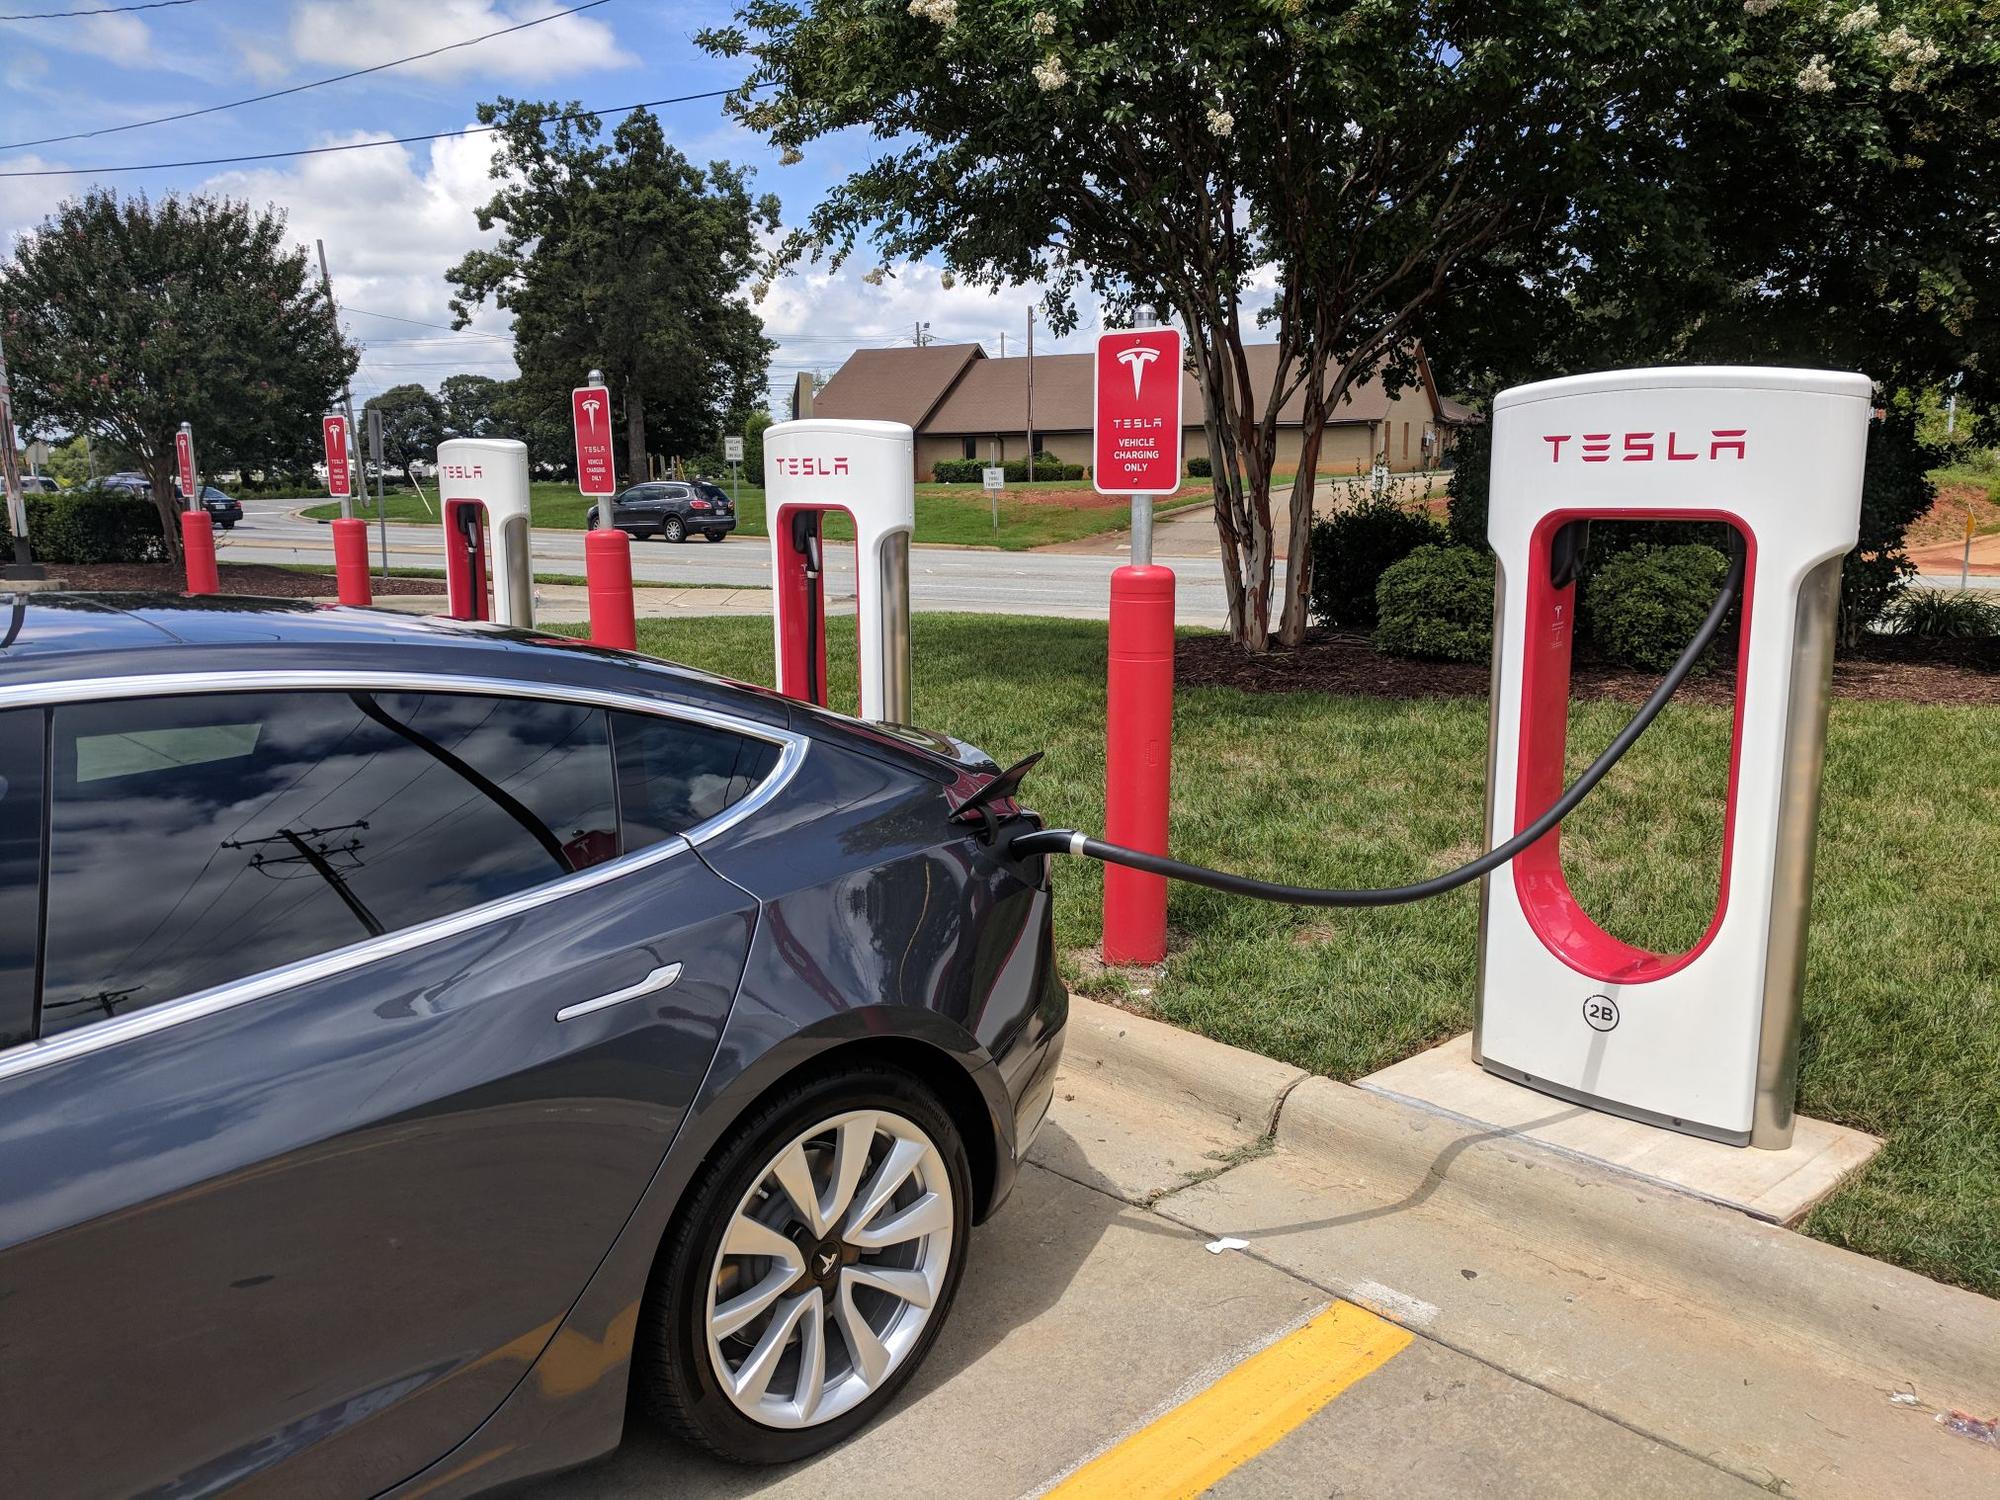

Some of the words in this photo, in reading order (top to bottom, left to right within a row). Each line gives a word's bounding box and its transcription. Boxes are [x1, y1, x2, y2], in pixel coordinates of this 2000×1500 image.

[1113, 418, 1162, 429] TESLA
[1118, 438, 1155, 447] VEHICLE
[1543, 430, 1747, 463] TESLA
[1113, 451, 1159, 460] CHARGING
[776, 457, 848, 475] TESLA
[1124, 463, 1148, 472] ONLY
[442, 466, 482, 478] TESLA
[1589, 1004, 1613, 1021] 2B
